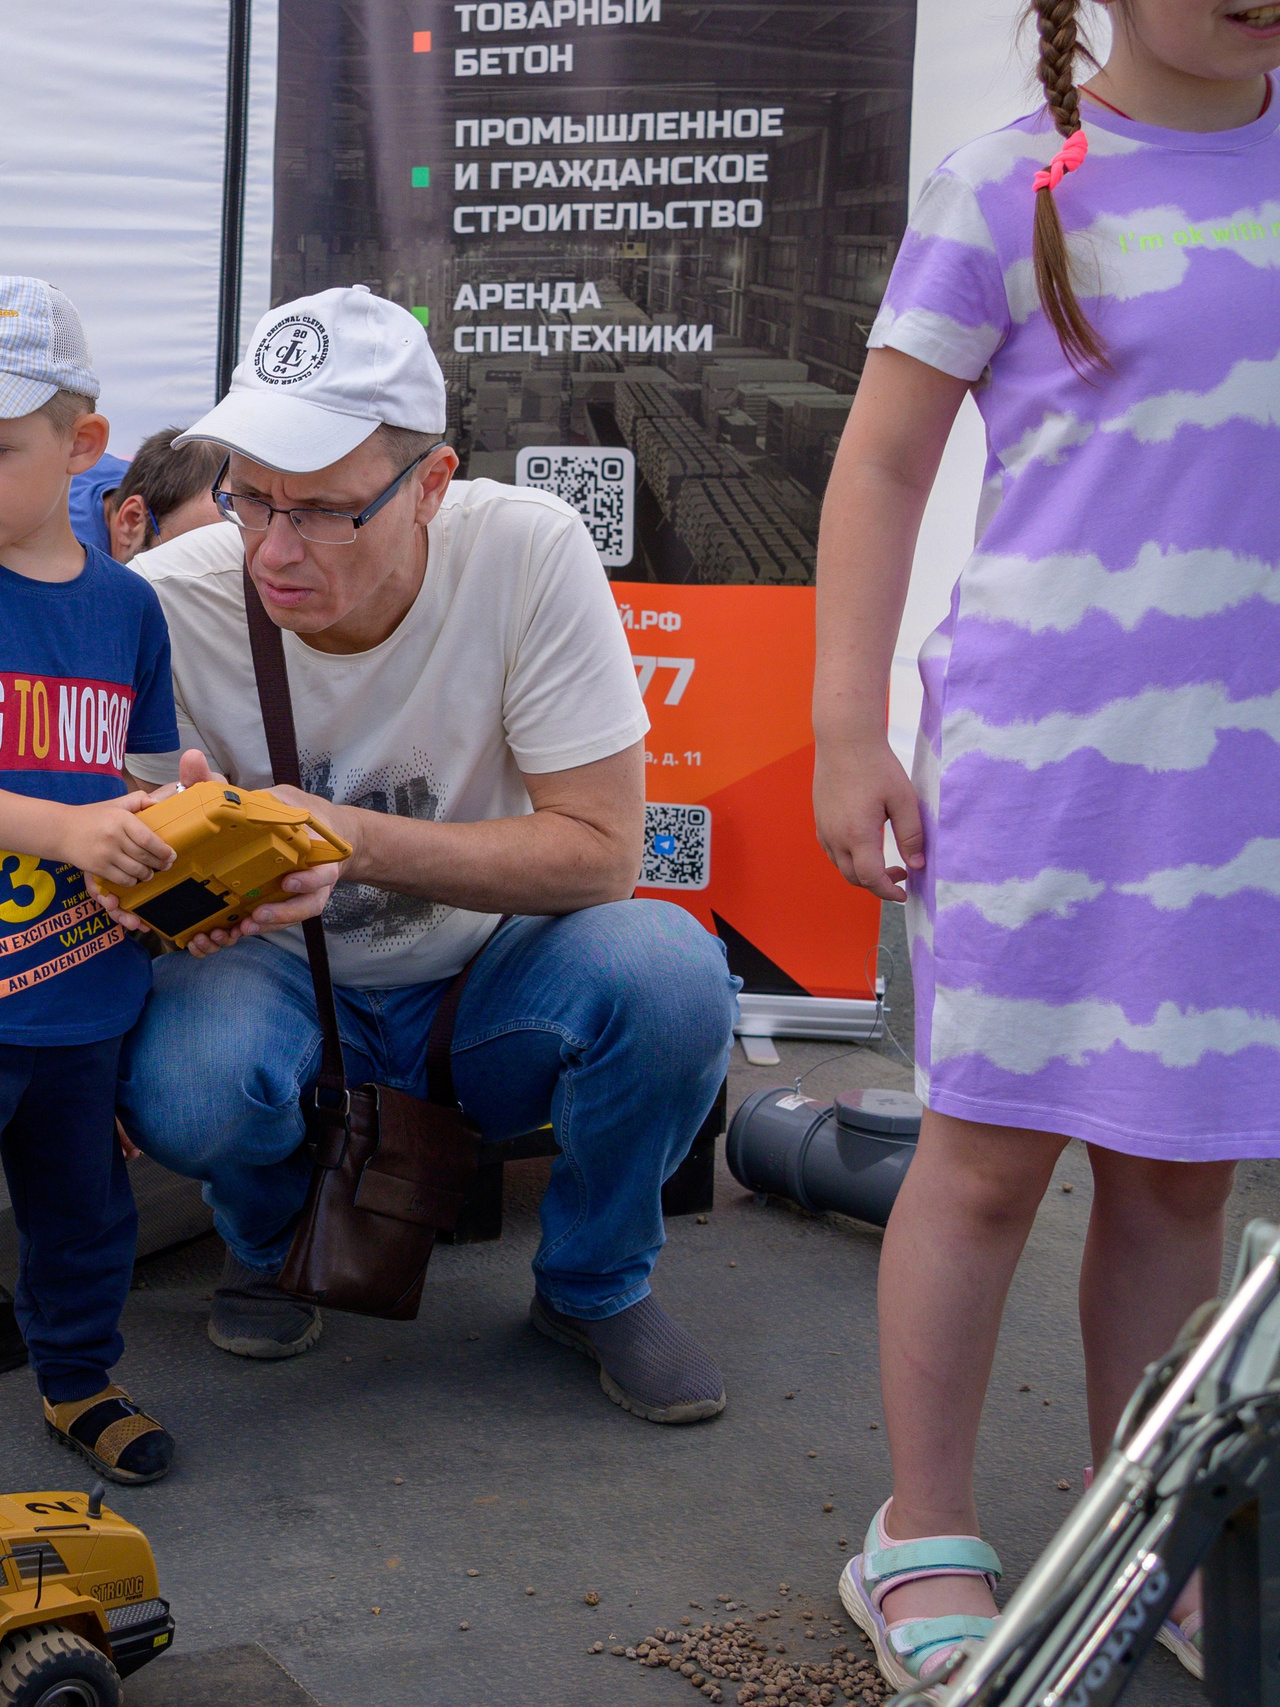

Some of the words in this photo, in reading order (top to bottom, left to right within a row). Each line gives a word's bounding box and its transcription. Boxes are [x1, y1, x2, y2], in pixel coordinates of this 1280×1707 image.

[454, 44, 573, 76] БЕТОН
[454, 108, 784, 148] ПРОМЫШЛЕННОЕ
[454, 163, 478, 190] И
[489, 153, 769, 191] ГРАЖДАНСКОЕ
[453, 198, 763, 234] СТРОИТЕЛЬСТВО
[1172, 225, 1206, 246] ok
[1211, 220, 1266, 244] with
[453, 281, 601, 312] АРЕНДА
[292, 329, 308, 339] 20
[302, 316, 326, 335] CLEVER
[453, 324, 713, 355] СПЕЦТЕХНИКИ
[272, 365, 288, 374] 04
[15, 679, 50, 759] TO
[683, 751, 702, 767] 11
[61, 897, 79, 909] THE
[11, 913, 72, 949] EXCITING
[8, 975, 29, 992] AN
[33, 941, 105, 982] ADVENTURE
[107, 929, 120, 945] IS
[90, 1575, 144, 1602] STRONG
